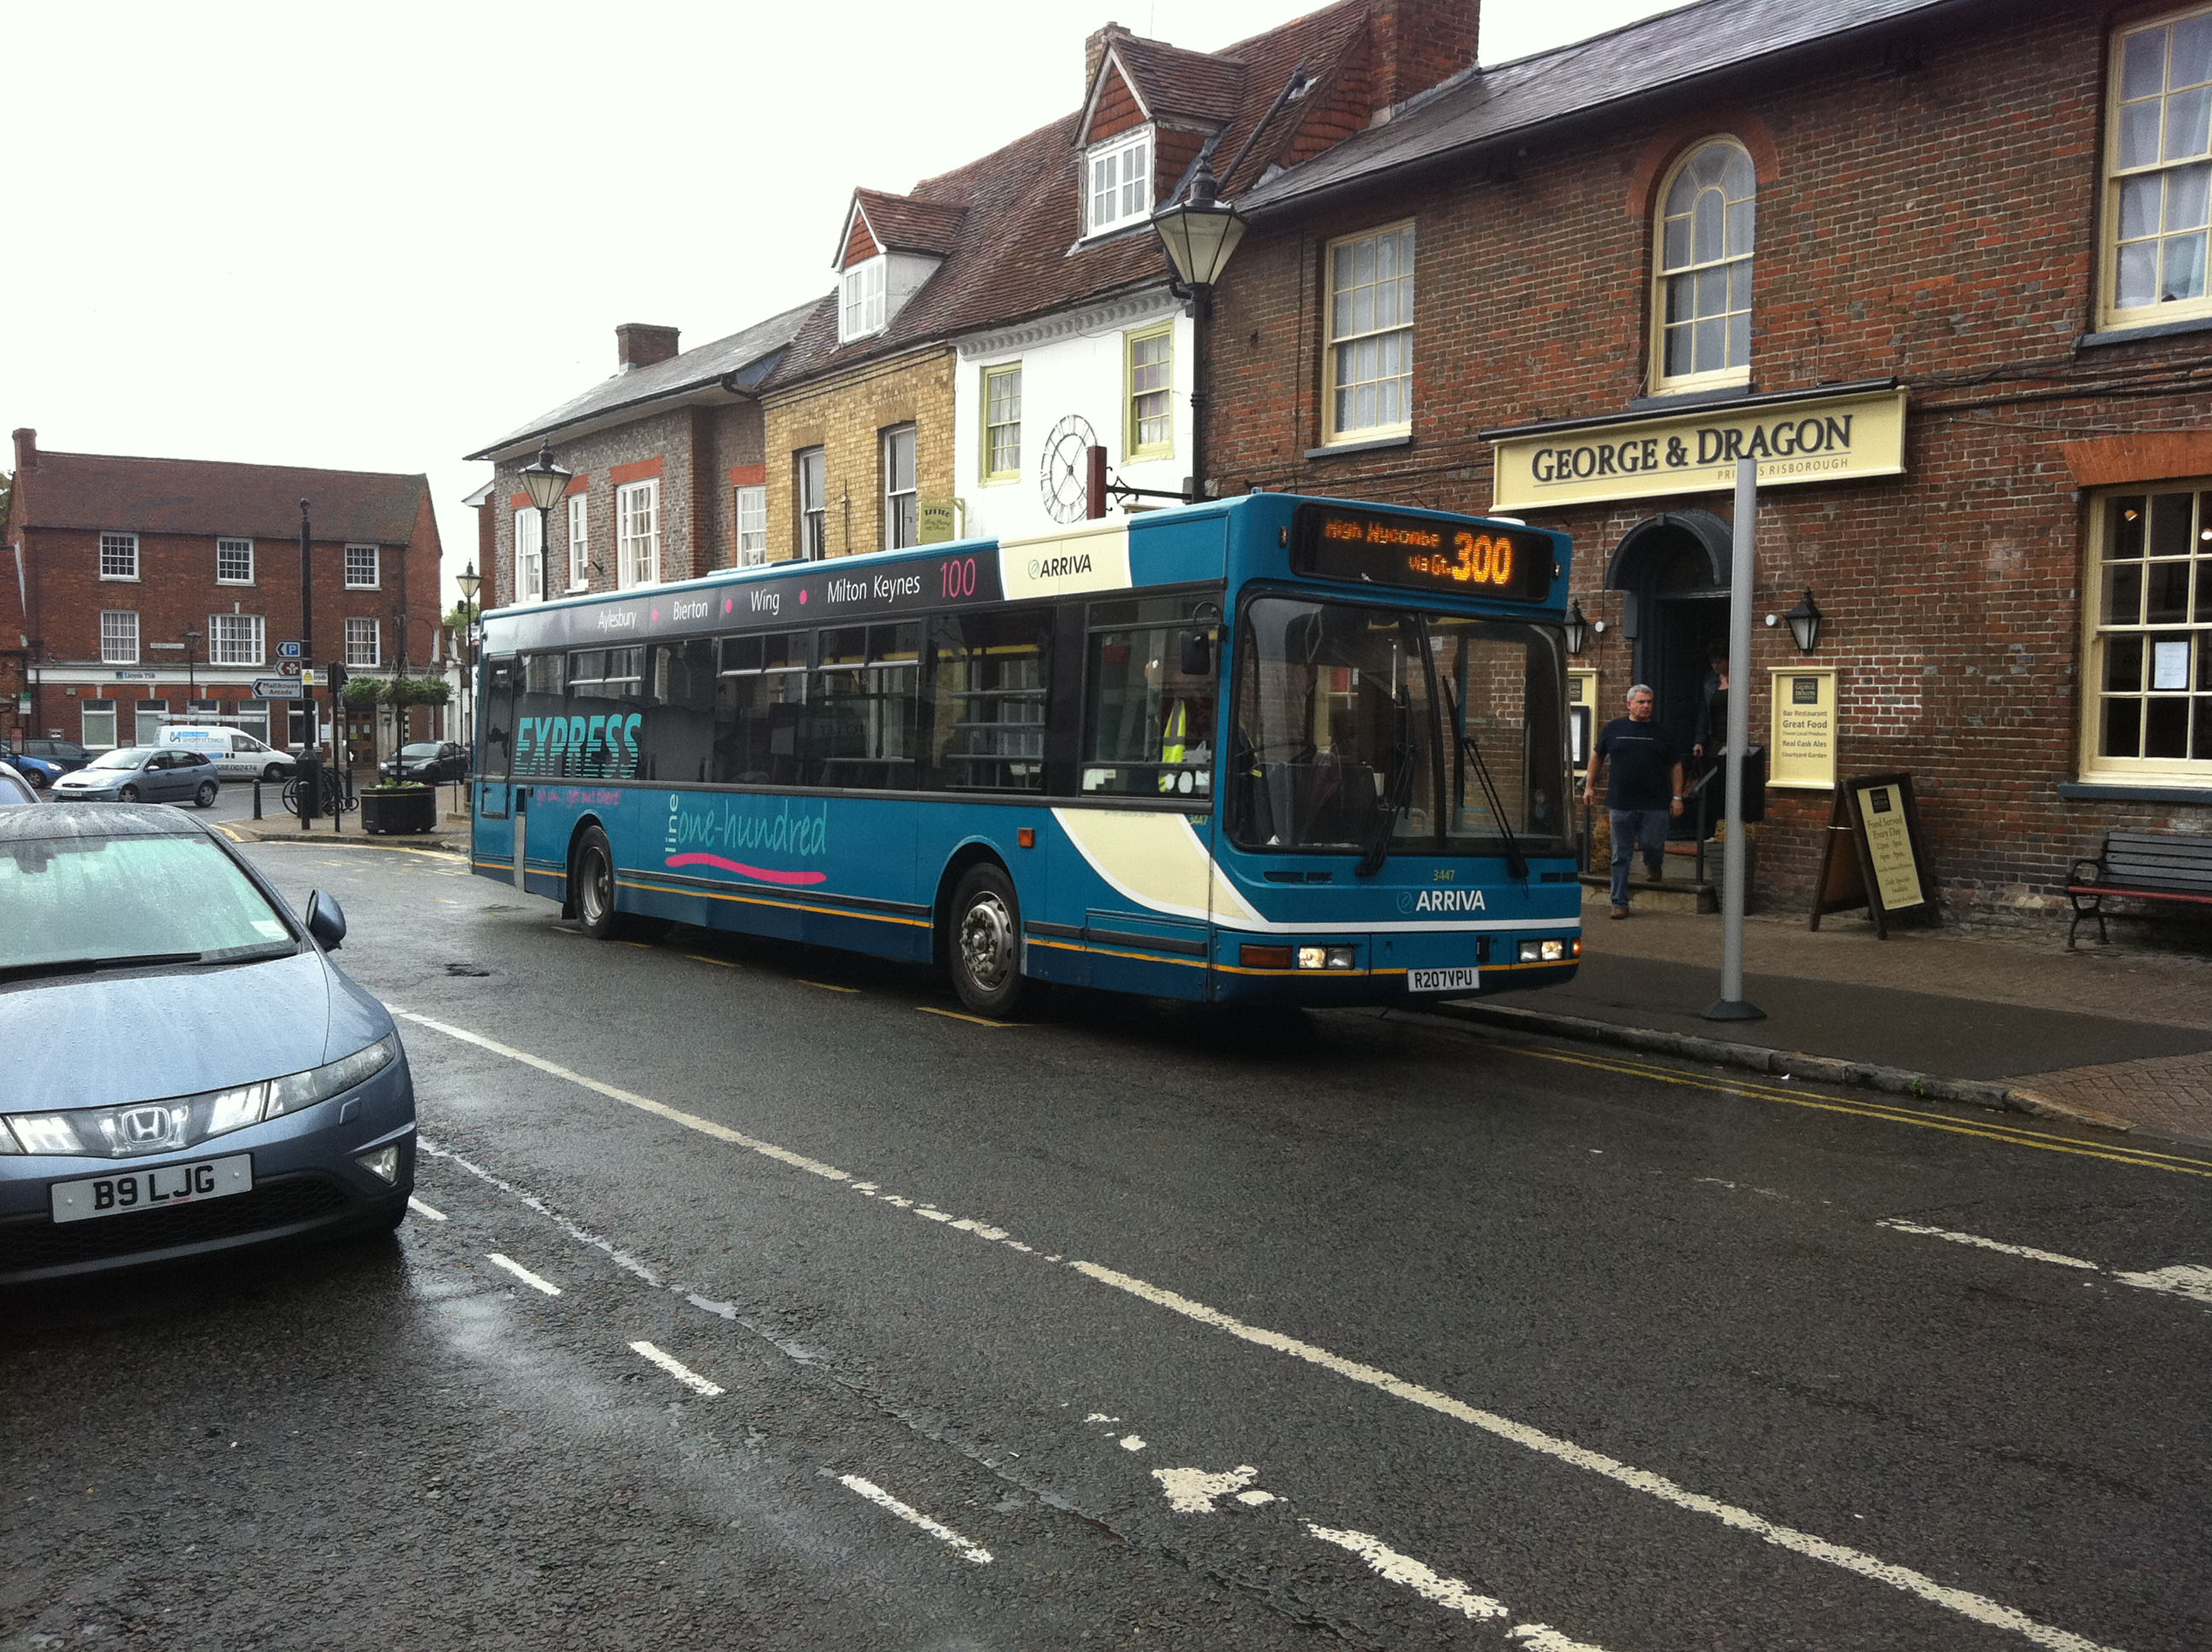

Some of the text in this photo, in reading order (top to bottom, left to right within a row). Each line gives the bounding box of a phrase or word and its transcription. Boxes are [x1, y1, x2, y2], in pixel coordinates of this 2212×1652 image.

[1532, 415, 1853, 483] GEORGE & DRAGON
[1717, 458, 1848, 480] PRIS RISBOROUGH
[1039, 554, 1091, 579] ARRIVA
[1325, 518, 1511, 585] High Wycombe 300
[1408, 556, 1428, 572] via
[940, 558, 976, 598] 100
[598, 574, 921, 633] Aylesbury Bierton Wing Milton Keynes
[125, 672, 143, 680] Lloyds
[1782, 720, 1828, 729] Great Food
[513, 713, 643, 779] EXPRESS
[665, 794, 678, 853] line
[678, 799, 828, 856] one-hundred
[1433, 870, 1455, 881] 3447
[1416, 890, 1486, 912] ARRIVA
[1414, 969, 1473, 988] R207VPU
[92, 1165, 215, 1210] B9 LJG
